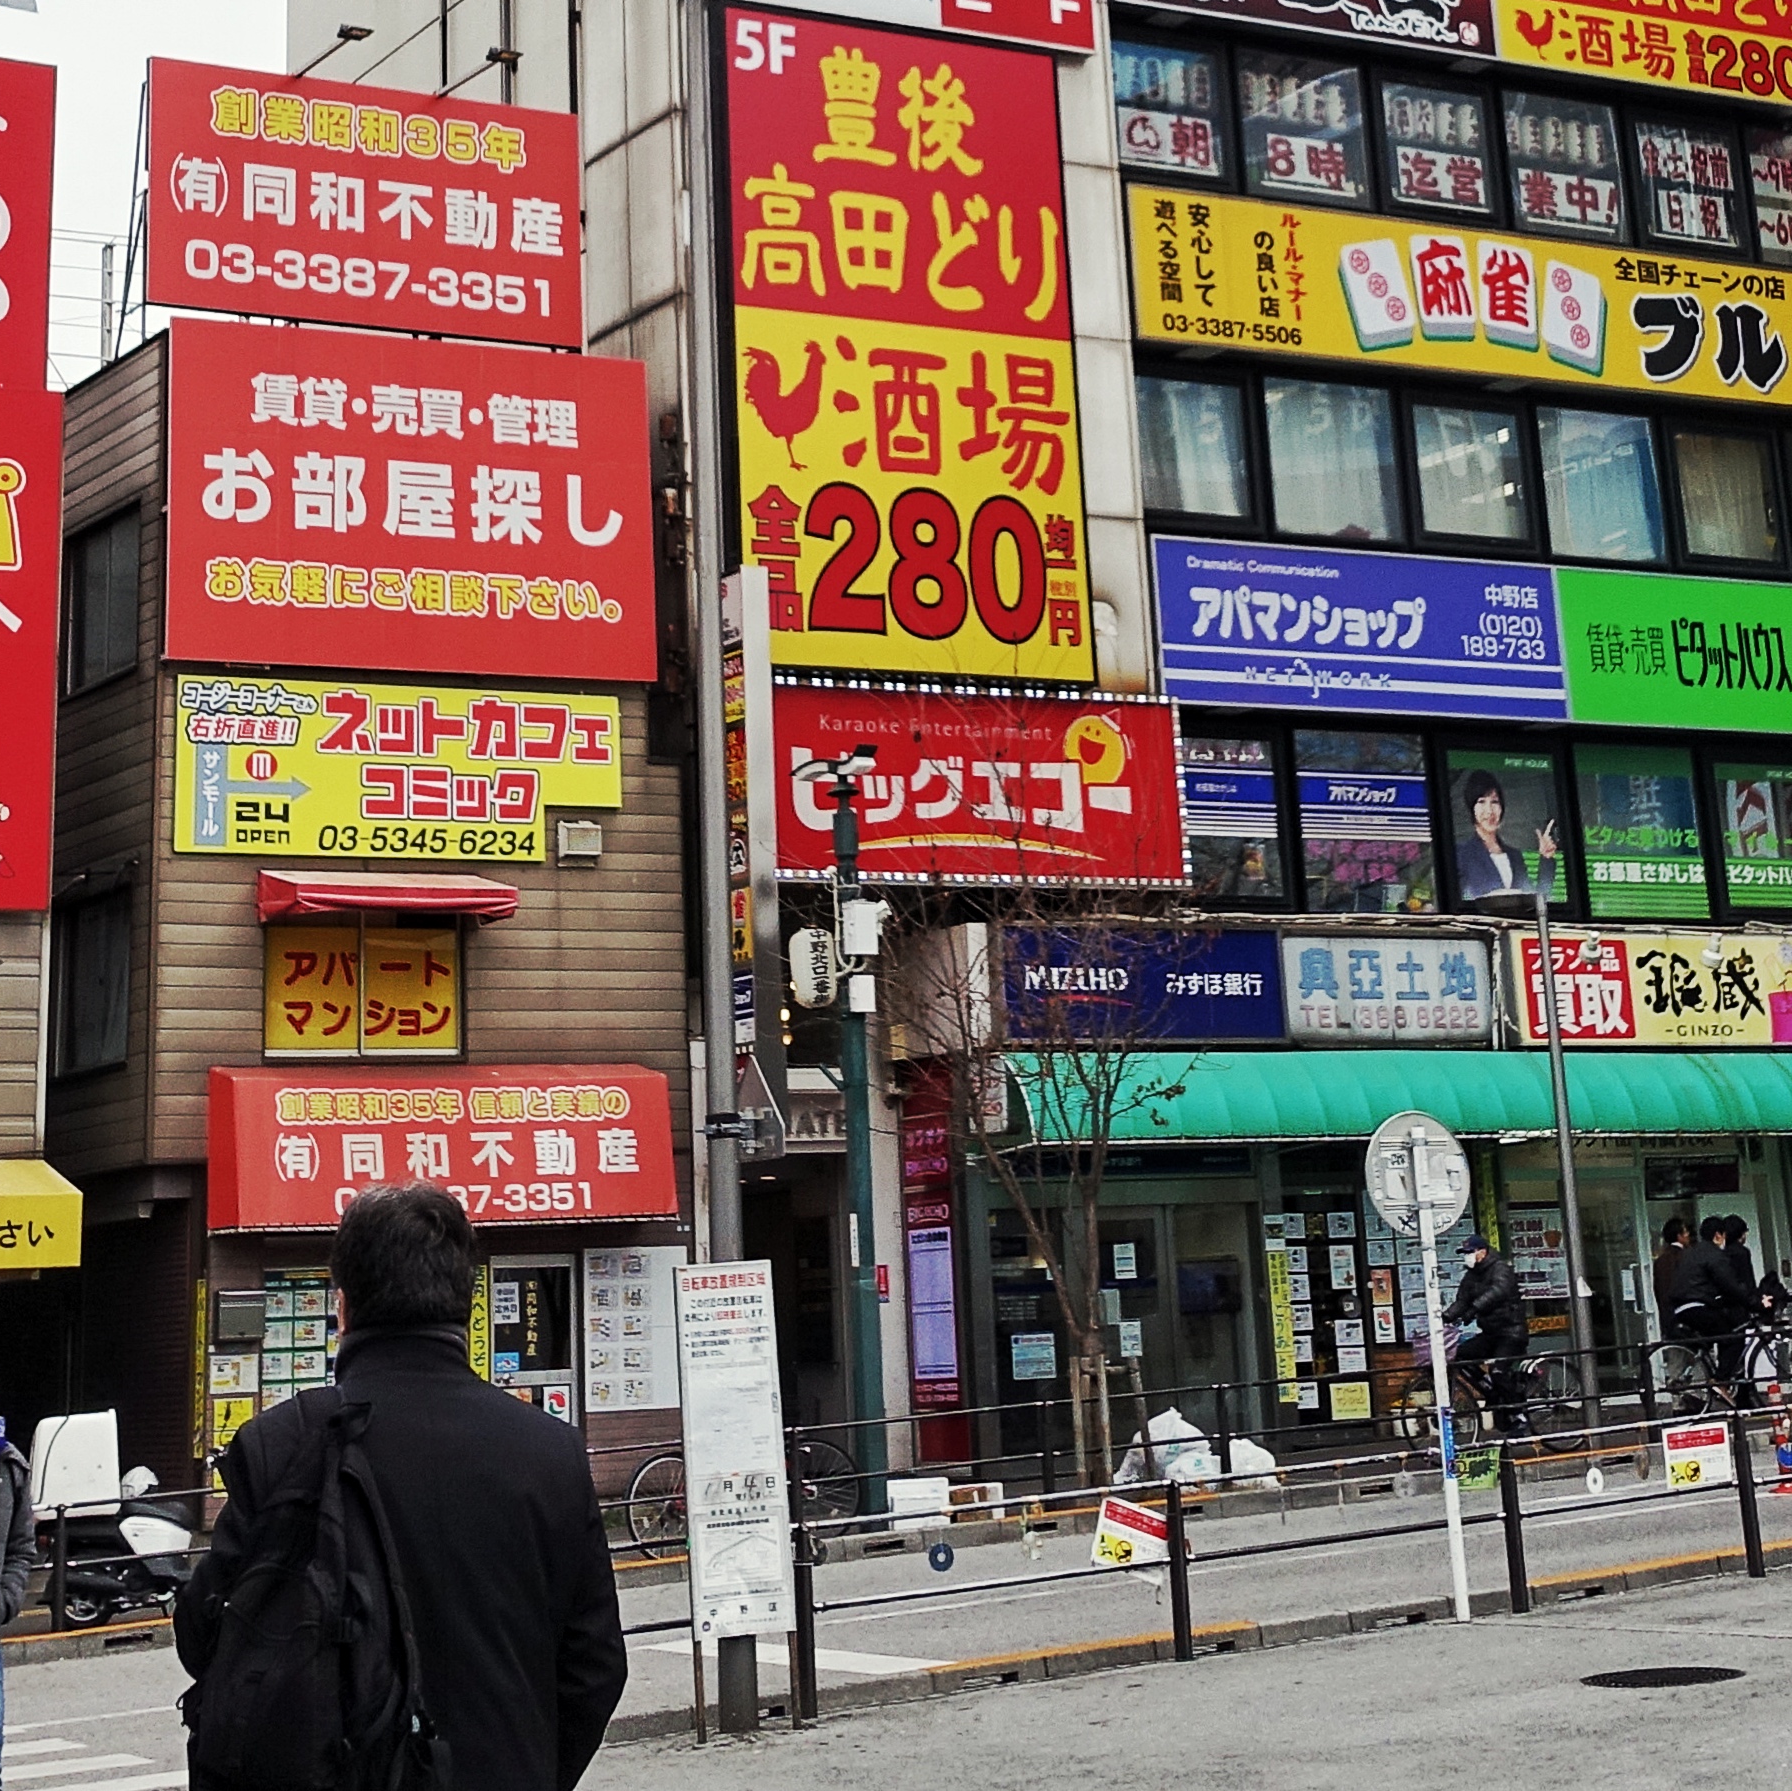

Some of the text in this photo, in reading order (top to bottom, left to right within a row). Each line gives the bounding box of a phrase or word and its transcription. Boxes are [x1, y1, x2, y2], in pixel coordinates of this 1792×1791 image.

[734, 19, 797, 75] 5F
[1559, 8, 1677, 81] 酒場
[210, 86, 527, 173] 創業昭和35年
[812, 45, 985, 177] 豊後
[1169, 116, 1211, 168] 朝
[1519, 174, 1620, 225] 業中!
[242, 161, 564, 258] 同和不動産
[741, 162, 1059, 323] 高田どり
[184, 238, 551, 317] 03-3387-3351
[1154, 198, 1184, 304] 遊べる空間
[1187, 202, 1217, 307] 安心して
[1254, 230, 1281, 319] の良い店
[1279, 213, 1308, 322] ルール・マナー
[1415, 238, 1530, 328] 麻雀
[1613, 256, 1786, 301] 全国チェーンの店
[1631, 293, 1788, 394] ブル
[250, 372, 579, 450] 賃貸・売買・管理
[832, 334, 1071, 496] 酒場
[201, 447, 624, 548] お部屋探し
[206, 557, 624, 624] お気軽にご相談下さい。
[748, 480, 1082, 647] 全品 280 円
[1247, 560, 1339, 579] Communication
[1189, 585, 1427, 649] アパマンショップ
[1478, 612, 1544, 638] (0120)
[1484, 584, 1539, 610] 中野店
[1460, 634, 1546, 661] 189-733
[187, 714, 300, 745] 右折直進!!
[316, 688, 615, 765] ネットカフェ
[818, 713, 1054, 742] Karaoke Entertainment
[201, 751, 221, 838] サンモール
[235, 801, 290, 823] 24
[361, 762, 540, 825] コミック
[789, 745, 1132, 834] ビッグエコー
[235, 828, 290, 845] OPEN
[317, 825, 536, 857] 03-5345-6234
[1593, 862, 1705, 882] お部屋さがしは
[282, 950, 452, 988] アパート
[1023, 965, 1130, 993] MIZUHO
[1165, 971, 1264, 997] みずほ銀行
[1529, 945, 1620, 975] ブランド品
[1635, 947, 1766, 1020] 銀蔵
[284, 1000, 451, 1037] マンション
[1532, 972, 1630, 1037] 買取
[275, 1085, 631, 1126] 創業昭和35年 信頼と実績の
[342, 1127, 641, 1181] 同和不動産
